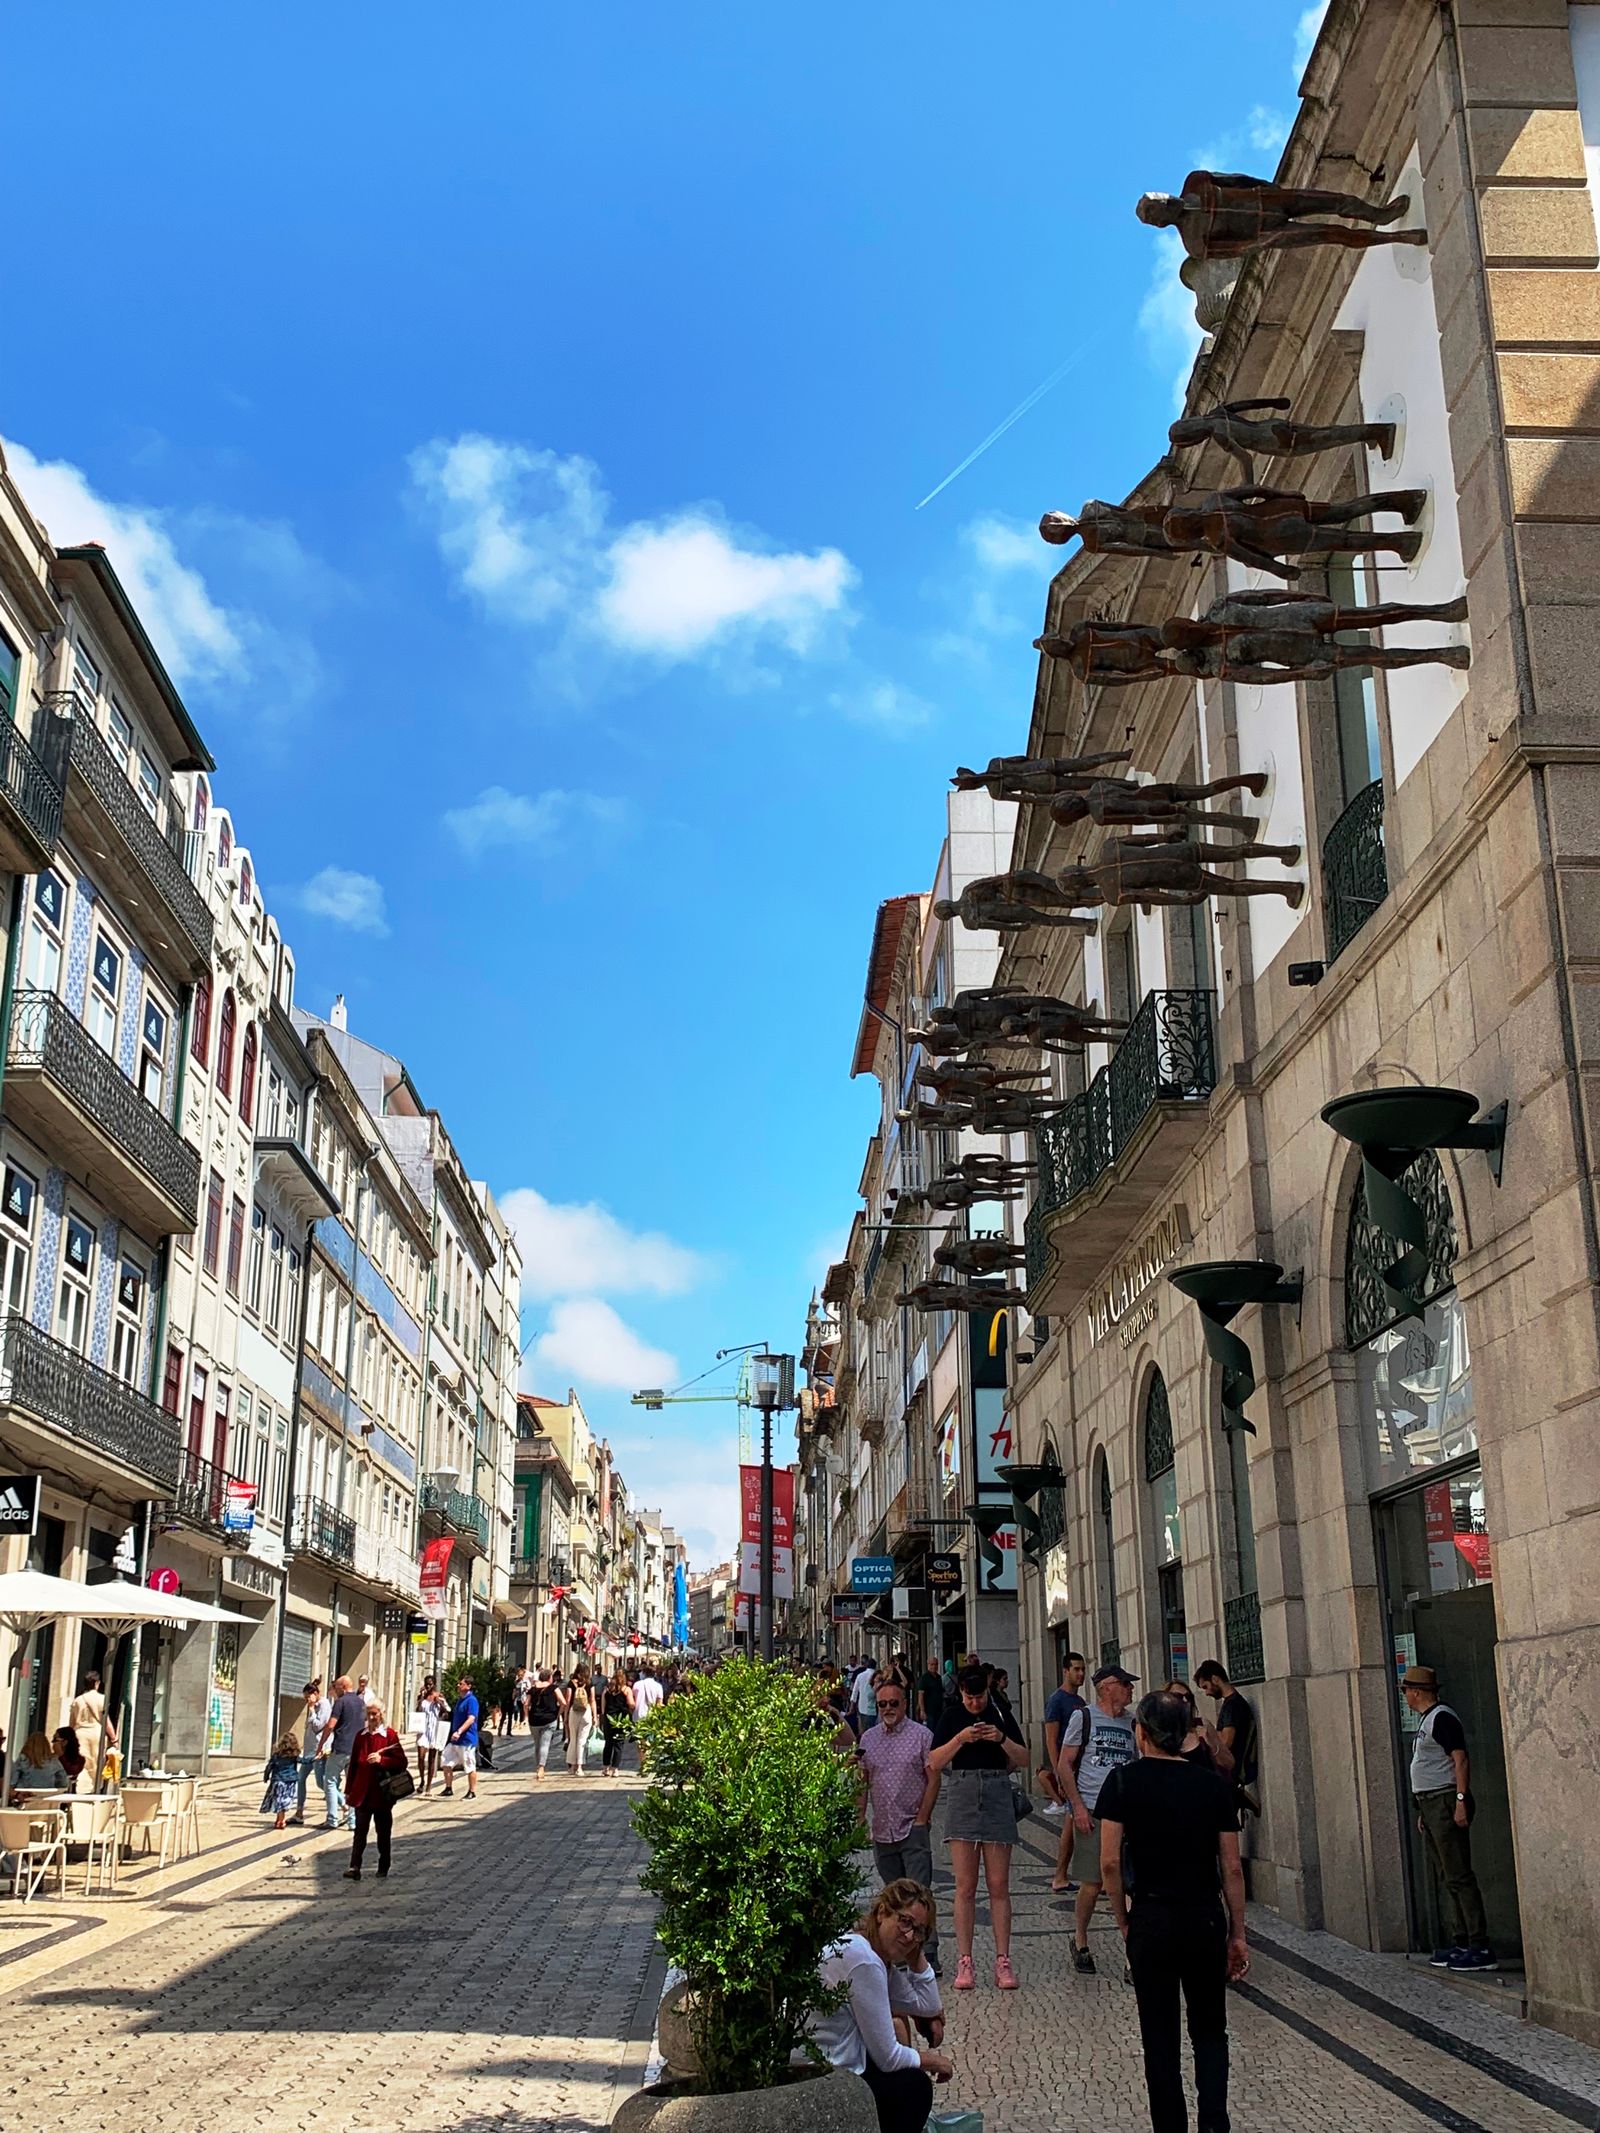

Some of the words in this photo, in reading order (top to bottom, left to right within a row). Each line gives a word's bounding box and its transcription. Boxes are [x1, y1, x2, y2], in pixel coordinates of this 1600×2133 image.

[1088, 1286, 1110, 1349] VIA
[1109, 1204, 1182, 1323] CATARINA
[1120, 1298, 1154, 1350] SHOPPING
